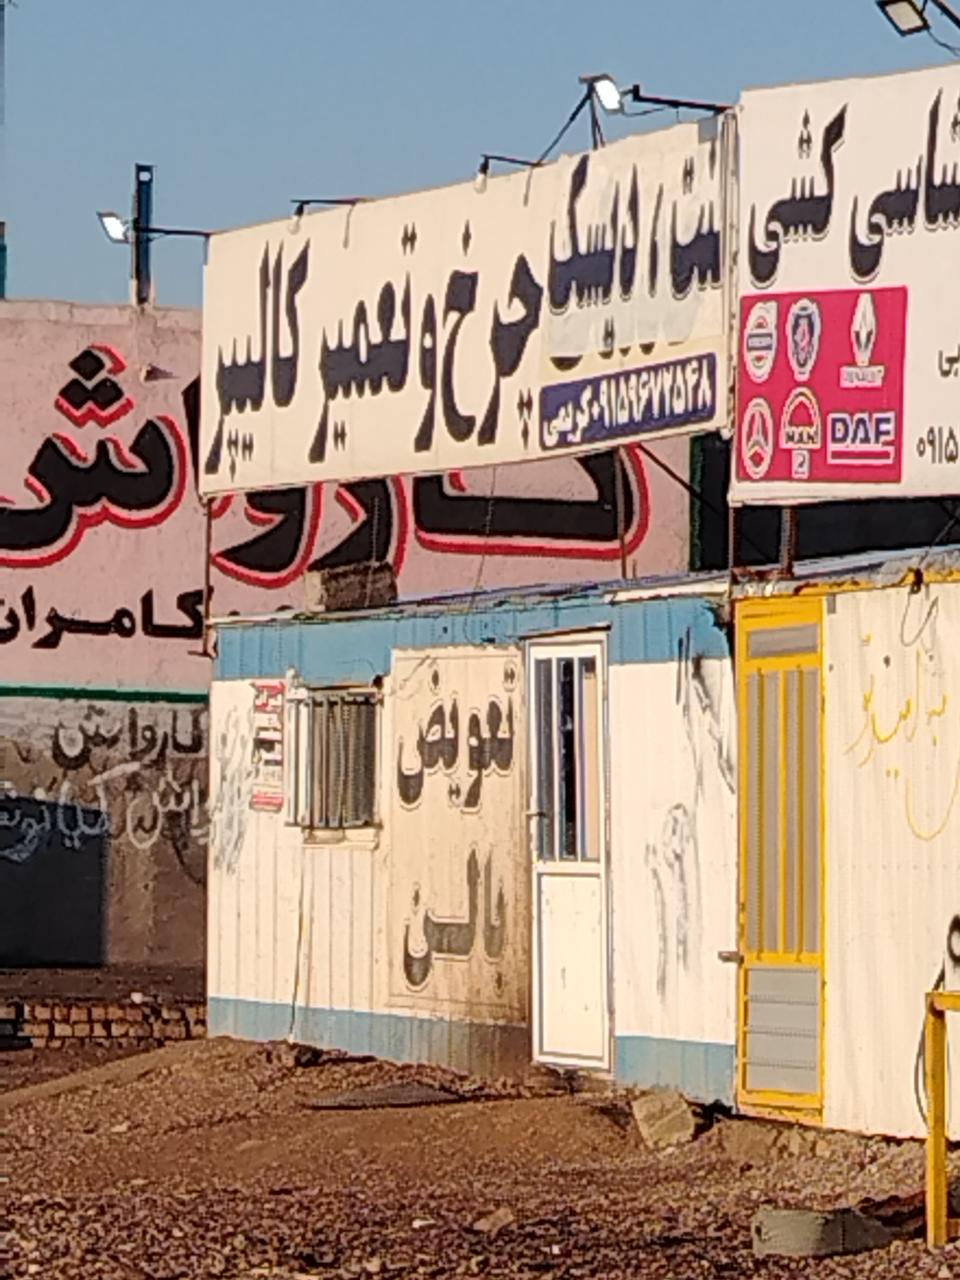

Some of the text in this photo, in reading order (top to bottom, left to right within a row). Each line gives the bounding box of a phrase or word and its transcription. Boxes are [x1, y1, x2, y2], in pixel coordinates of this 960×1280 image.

[748, 102, 849, 288] کشی
[204, 237, 310, 482] کالیپر
[307, 222, 418, 464] تعمیر
[413, 293, 436, 453] و
[443, 218, 544, 449] چرخ
[830, 417, 892, 445] DAF
[397, 662, 515, 810] تعویض
